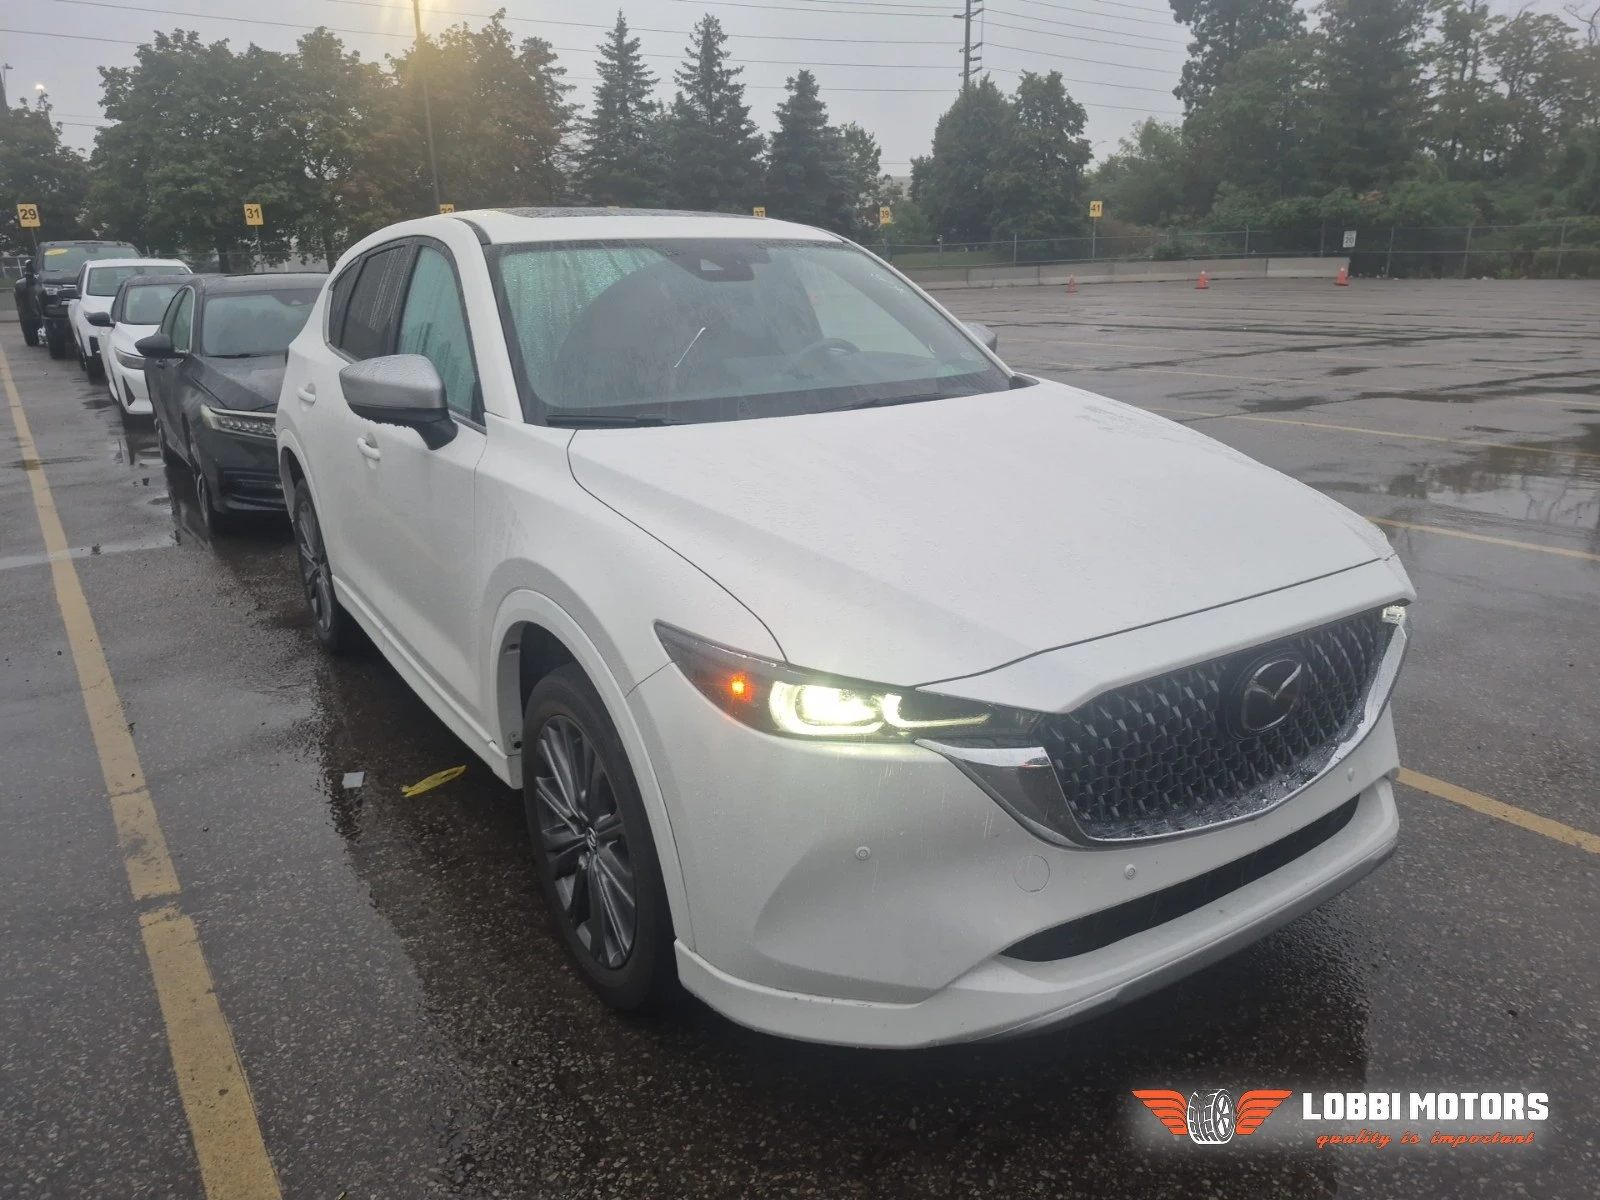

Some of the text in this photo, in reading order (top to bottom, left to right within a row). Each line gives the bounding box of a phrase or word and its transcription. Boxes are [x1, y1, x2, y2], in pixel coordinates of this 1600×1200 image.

[1090, 203, 1100, 212] 41
[20, 209, 37, 220] 29
[247, 208, 260, 219] 31
[881, 210, 890, 218] 39
